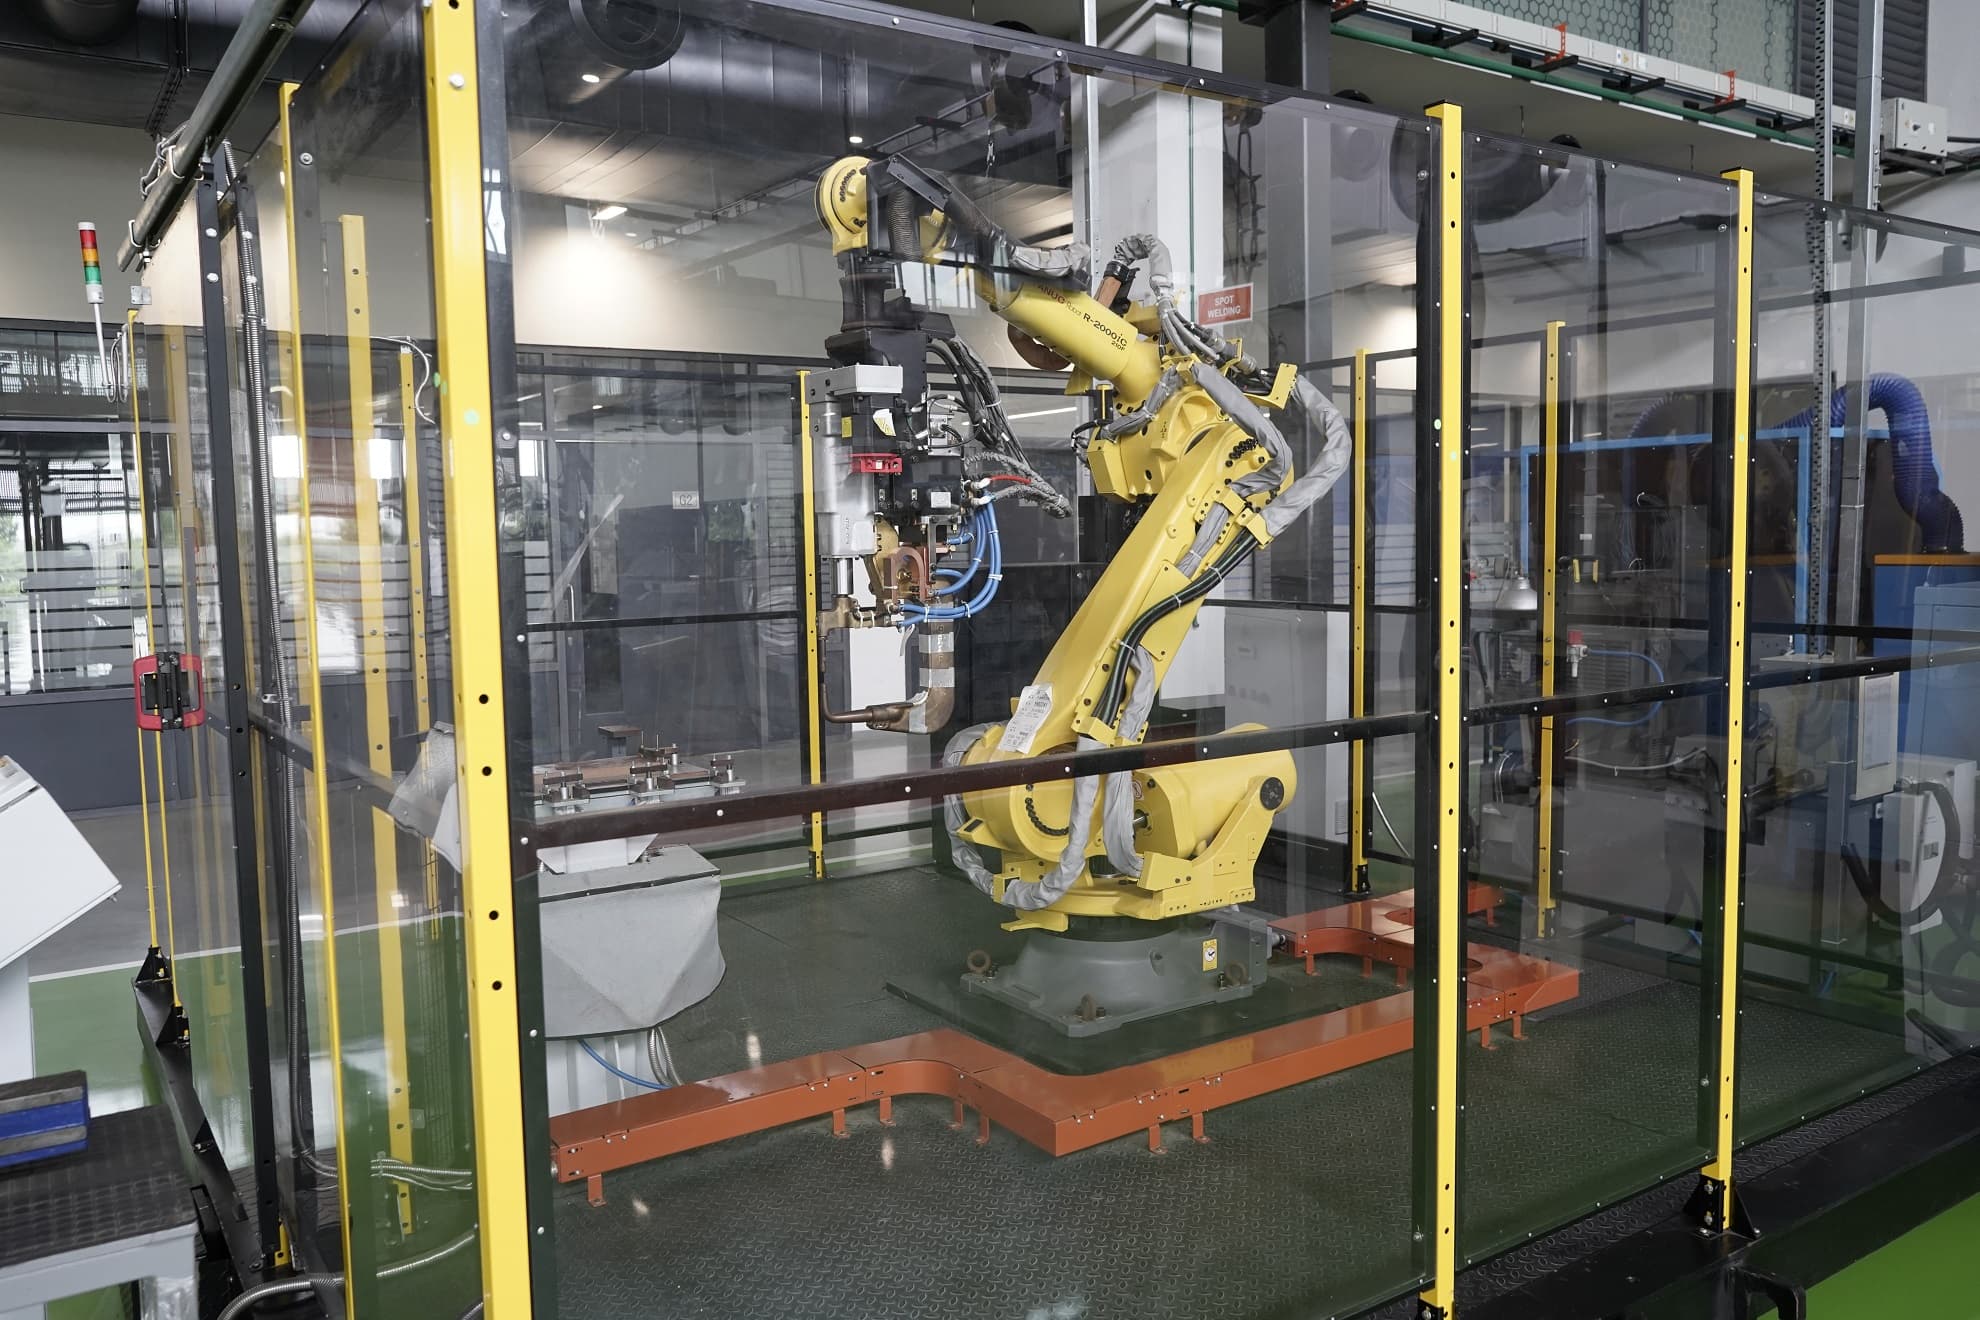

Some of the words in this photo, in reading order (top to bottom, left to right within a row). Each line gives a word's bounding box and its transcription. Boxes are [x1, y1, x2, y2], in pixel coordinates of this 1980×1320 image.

[1034, 284, 1065, 304] ANUC
[1215, 295, 1234, 306] SPOT
[1207, 305, 1241, 319] WELDING
[679, 494, 693, 506] G2
